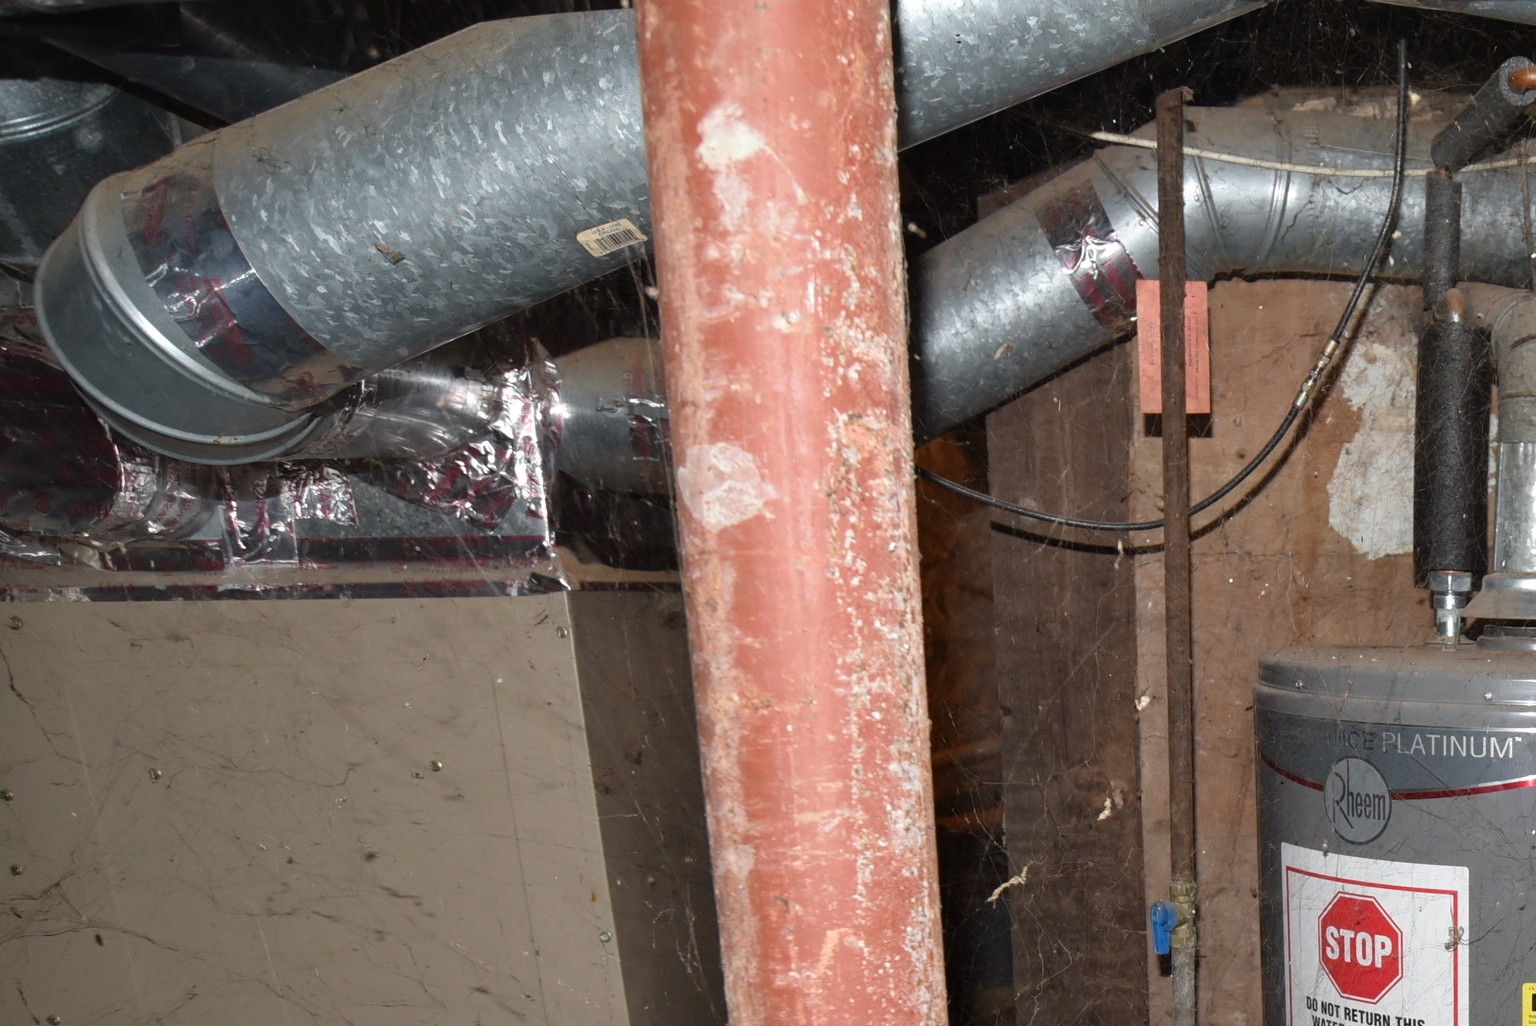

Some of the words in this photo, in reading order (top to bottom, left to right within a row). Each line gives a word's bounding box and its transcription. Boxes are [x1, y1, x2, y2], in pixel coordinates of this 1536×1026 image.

[1331, 759, 1387, 829] Rheem
[1325, 925, 1392, 968] STOP
[1306, 996, 1318, 1013] DO
[1321, 1003, 1340, 1019] NOT
